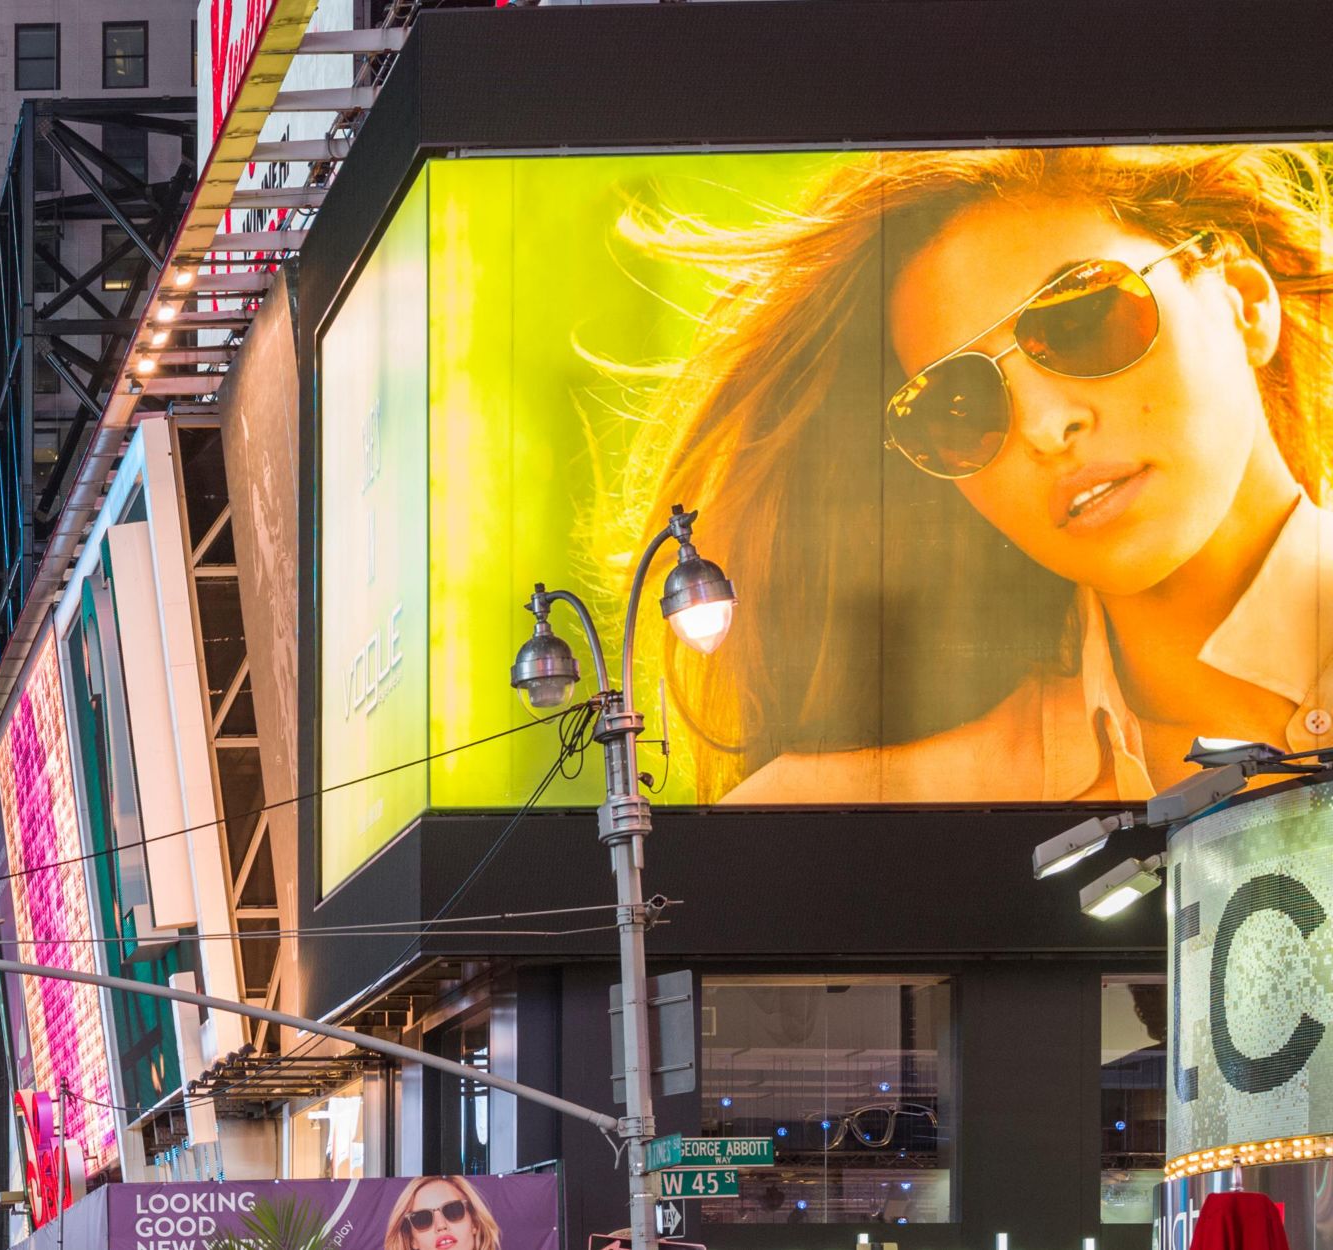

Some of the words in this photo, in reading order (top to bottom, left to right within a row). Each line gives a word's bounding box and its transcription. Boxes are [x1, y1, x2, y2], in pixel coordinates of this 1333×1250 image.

[726, 1140, 769, 1156] ABBOTT
[714, 1156, 733, 1165] WAY
[663, 1173, 684, 1195] W
[691, 1172, 719, 1194] 45
[724, 1172, 736, 1183] St
[135, 1192, 256, 1214] LOOKING
[135, 1216, 217, 1238] GOOD
